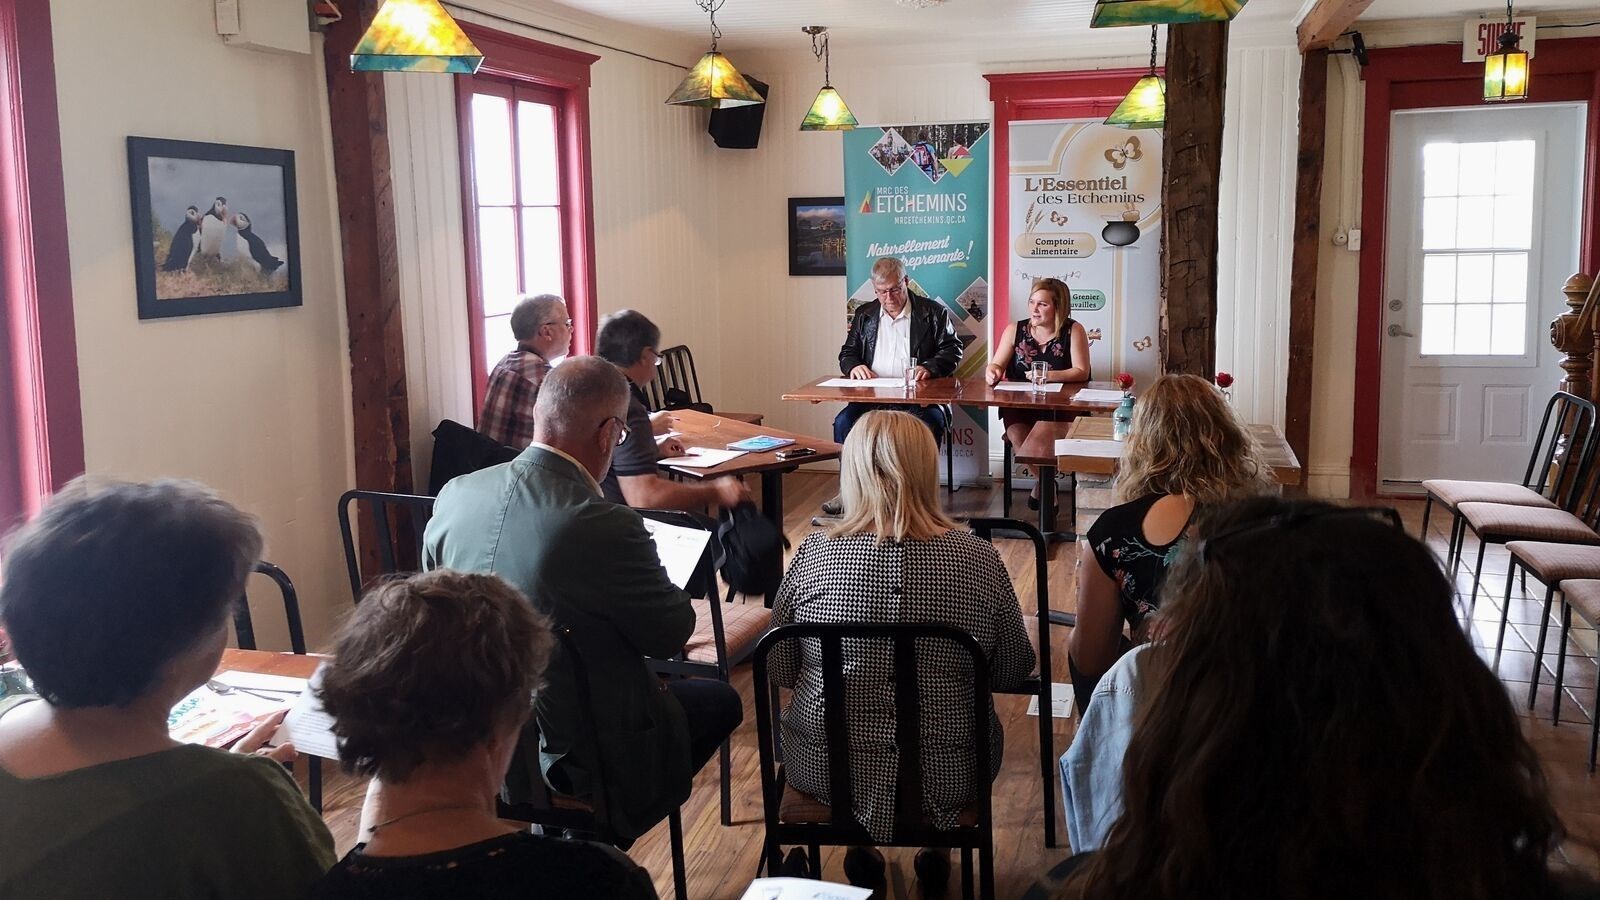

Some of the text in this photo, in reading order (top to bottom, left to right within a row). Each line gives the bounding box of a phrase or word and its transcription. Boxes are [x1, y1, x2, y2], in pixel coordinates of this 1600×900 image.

[1024, 176, 1128, 192] L'Essentiel
[877, 186, 909, 195] MRC DES
[877, 193, 967, 213] ETCHEMINS
[1037, 192, 1145, 205] des Etchemins
[894, 215, 966, 225] MRCETCHEMINS.QC.CA
[867, 236, 950, 258] Naturellement
[1035, 238, 1074, 246] Comptoir
[1031, 247, 1079, 255] alimentaire
